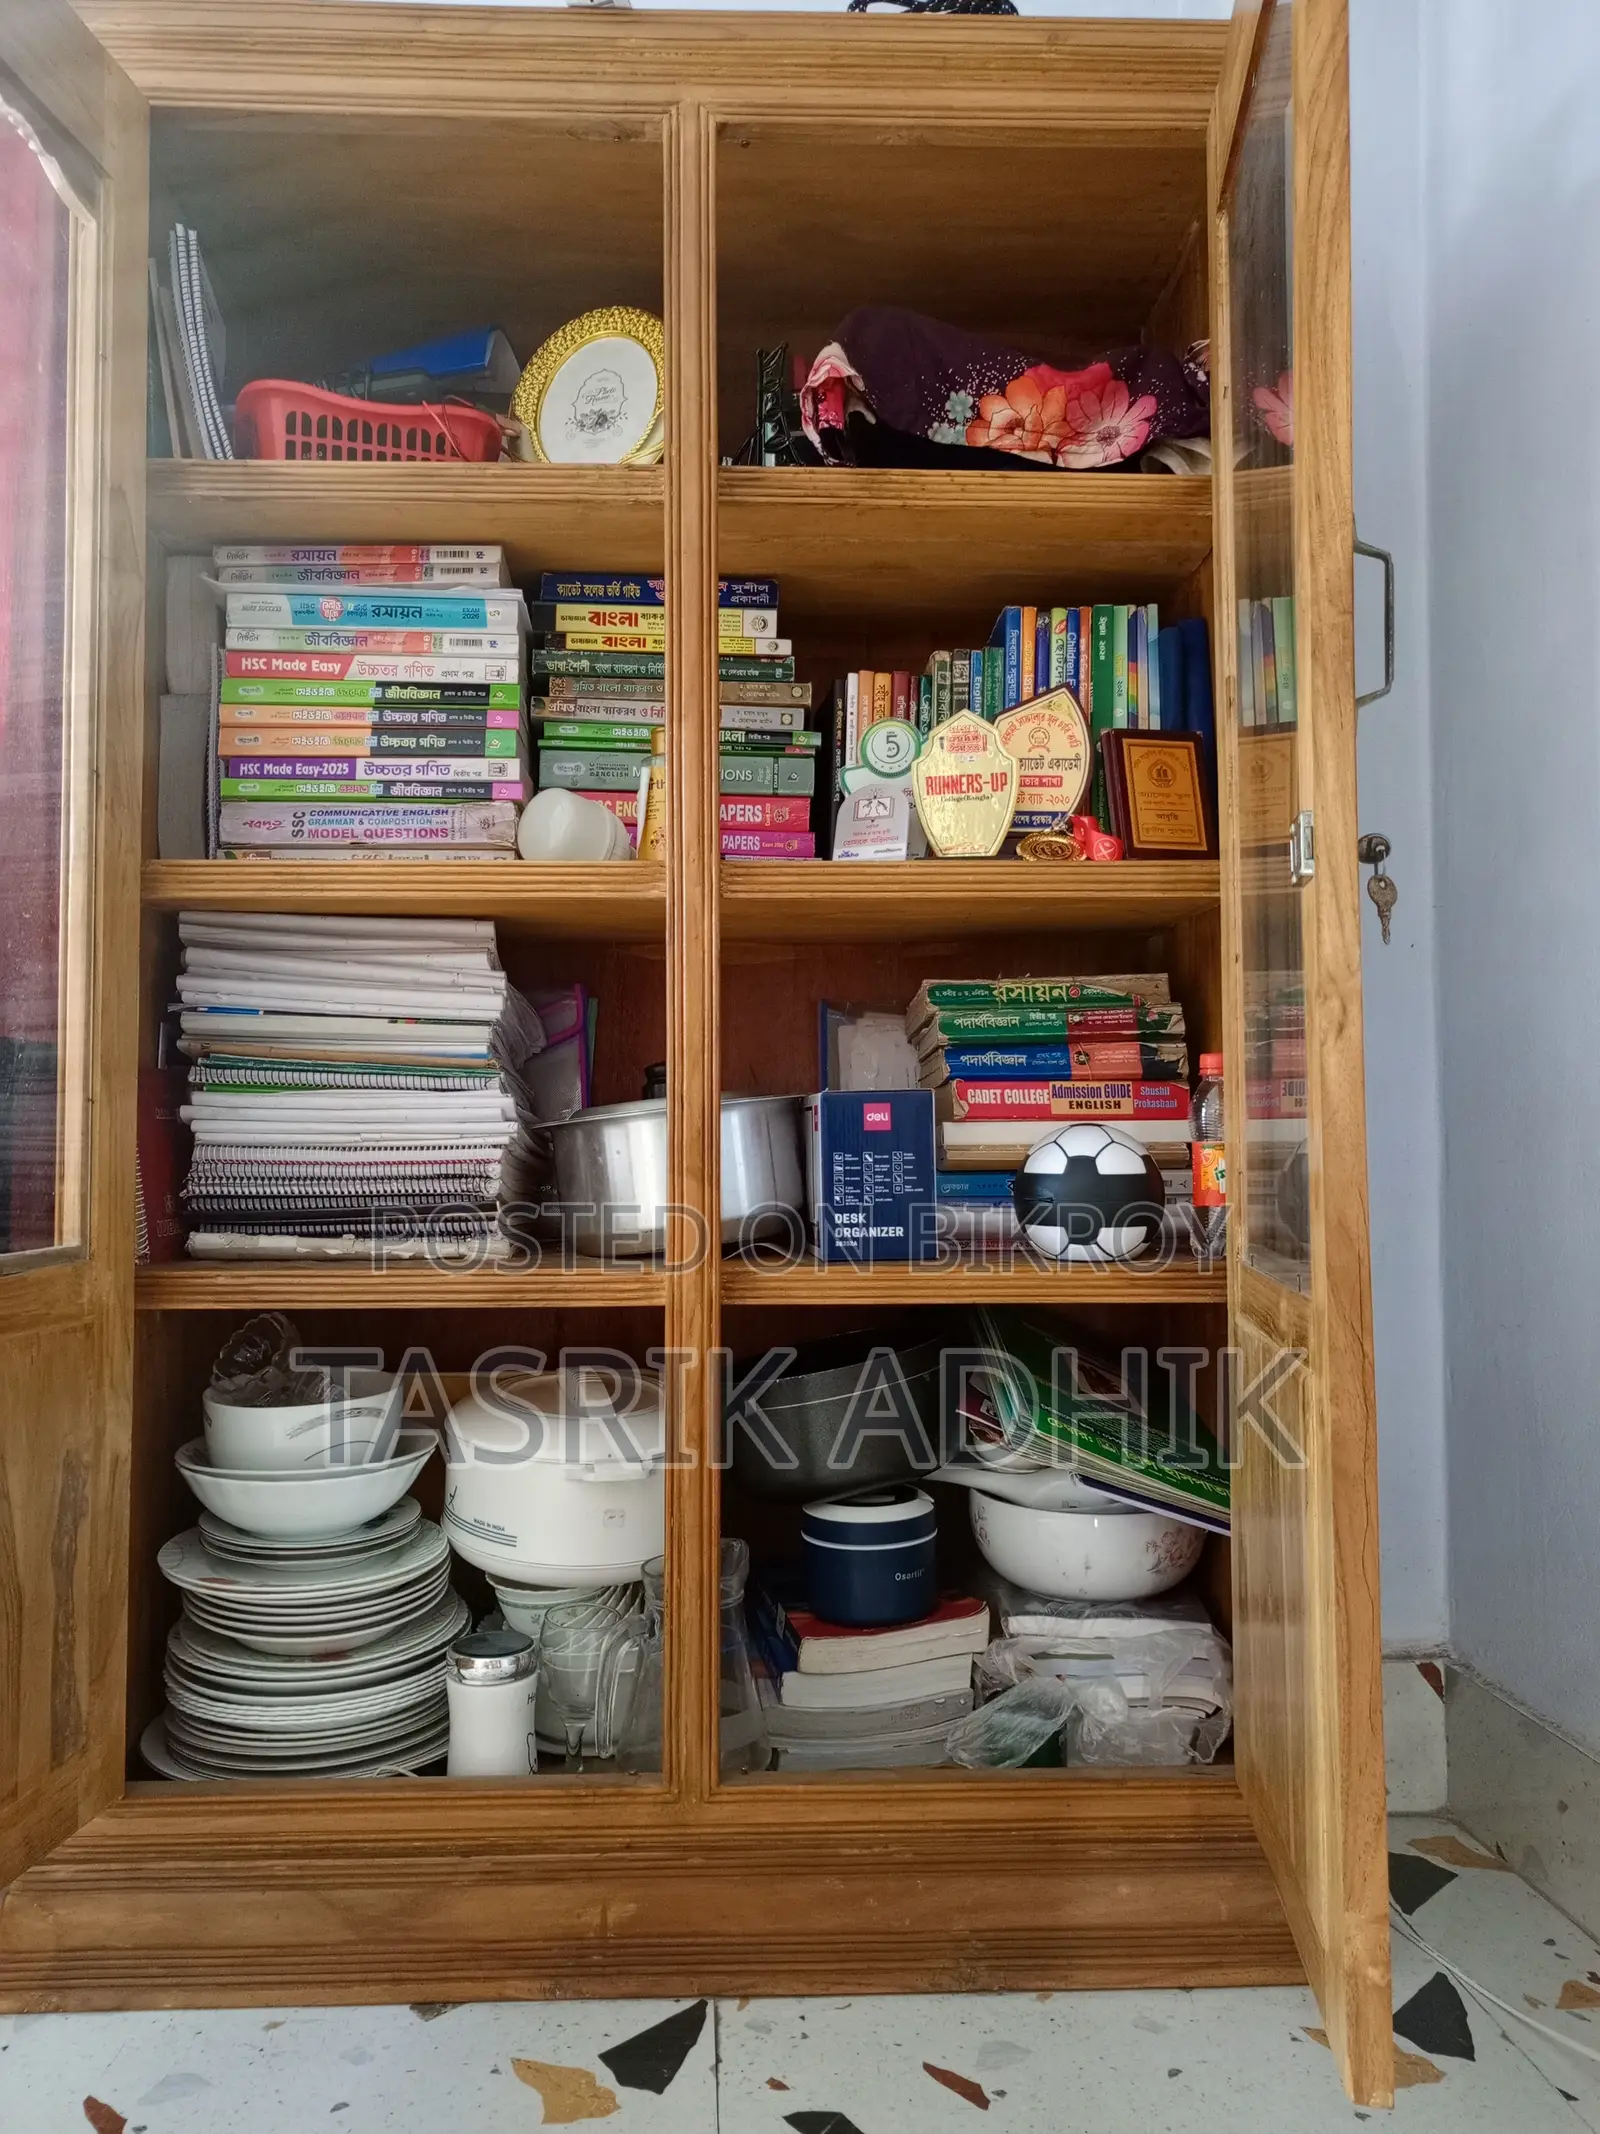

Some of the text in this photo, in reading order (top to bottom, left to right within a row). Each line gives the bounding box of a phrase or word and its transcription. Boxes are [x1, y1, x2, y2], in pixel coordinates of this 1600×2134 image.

[291, 550, 336, 562] রসায়ন
[297, 568, 359, 581] জীববিজ্ঞান
[557, 582, 581, 597] ক্যাডেট
[583, 584, 605, 598] কলেজ
[606, 581, 621, 597] ভর্তি
[622, 582, 641, 599] গাইড
[731, 582, 770, 594] সুশীল
[730, 593, 770, 604] প্রকাশনী
[371, 604, 422, 619] রসায়ন
[588, 611, 639, 627] বাংলা
[640, 613, 664, 621] ব্যাকর
[304, 631, 368, 647] জীববিজ্ঞান
[601, 636, 647, 648] বাংলা
[1067, 632, 1077, 675] Children
[241, 657, 341, 674] HSC Made Easy
[356, 660, 475, 679] উচ্চতর গণিত প্রথম পত্র
[546, 658, 590, 673] ভাষা-শৈলী
[384, 685, 441, 699] জীববিজ্ঞান
[572, 681, 595, 694] প্রমিত
[597, 682, 621, 693] বাংলা
[623, 683, 653, 693] ব্যাকরণ
[973, 676, 982, 715] English
[548, 700, 576, 713] প্রমিত
[577, 703, 601, 714] বাংলা
[603, 705, 636, 716] ব্যাকরণ
[897, 695, 905, 720] রাশিয়া
[938, 689, 949, 721] জীববি
[383, 710, 447, 723] উচ্চতর গণিত
[380, 734, 446, 748] উচ্চতর গণিত
[719, 730, 746, 742] াংলা
[886, 734, 901, 759] 5
[364, 761, 412, 776] উচ্চতর
[415, 760, 451, 776] গণিত
[1047, 752, 1082, 772] একাডেমী
[240, 763, 349, 778] HSC Made Easy-2025
[390, 783, 443, 796] জীববিজ্ঞান
[925, 772, 1008, 796] RUNNERS-UP
[1019, 776, 1062, 788] াভার শাখা
[720, 804, 763, 823] APERS
[292, 811, 305, 839] SSC
[368, 818, 432, 826] COMPOSITION
[308, 828, 449, 839] MODEL QUESTIONS
[722, 835, 760, 851] PAPERS
[992, 983, 1069, 1003] রসায়ন
[953, 1013, 1020, 1029] পদার্থবিজ্ঞান
[960, 1050, 1027, 1066] পদার্থবিজ্ঞান
[967, 1082, 1131, 1105] CADET COLLEGE Admission GUIDE
[1069, 1100, 1121, 1110] ENGLISH
[866, 1113, 889, 1121] deli
[835, 1212, 867, 1224] DESK
[835, 1226, 904, 1238] ORGANIZER
